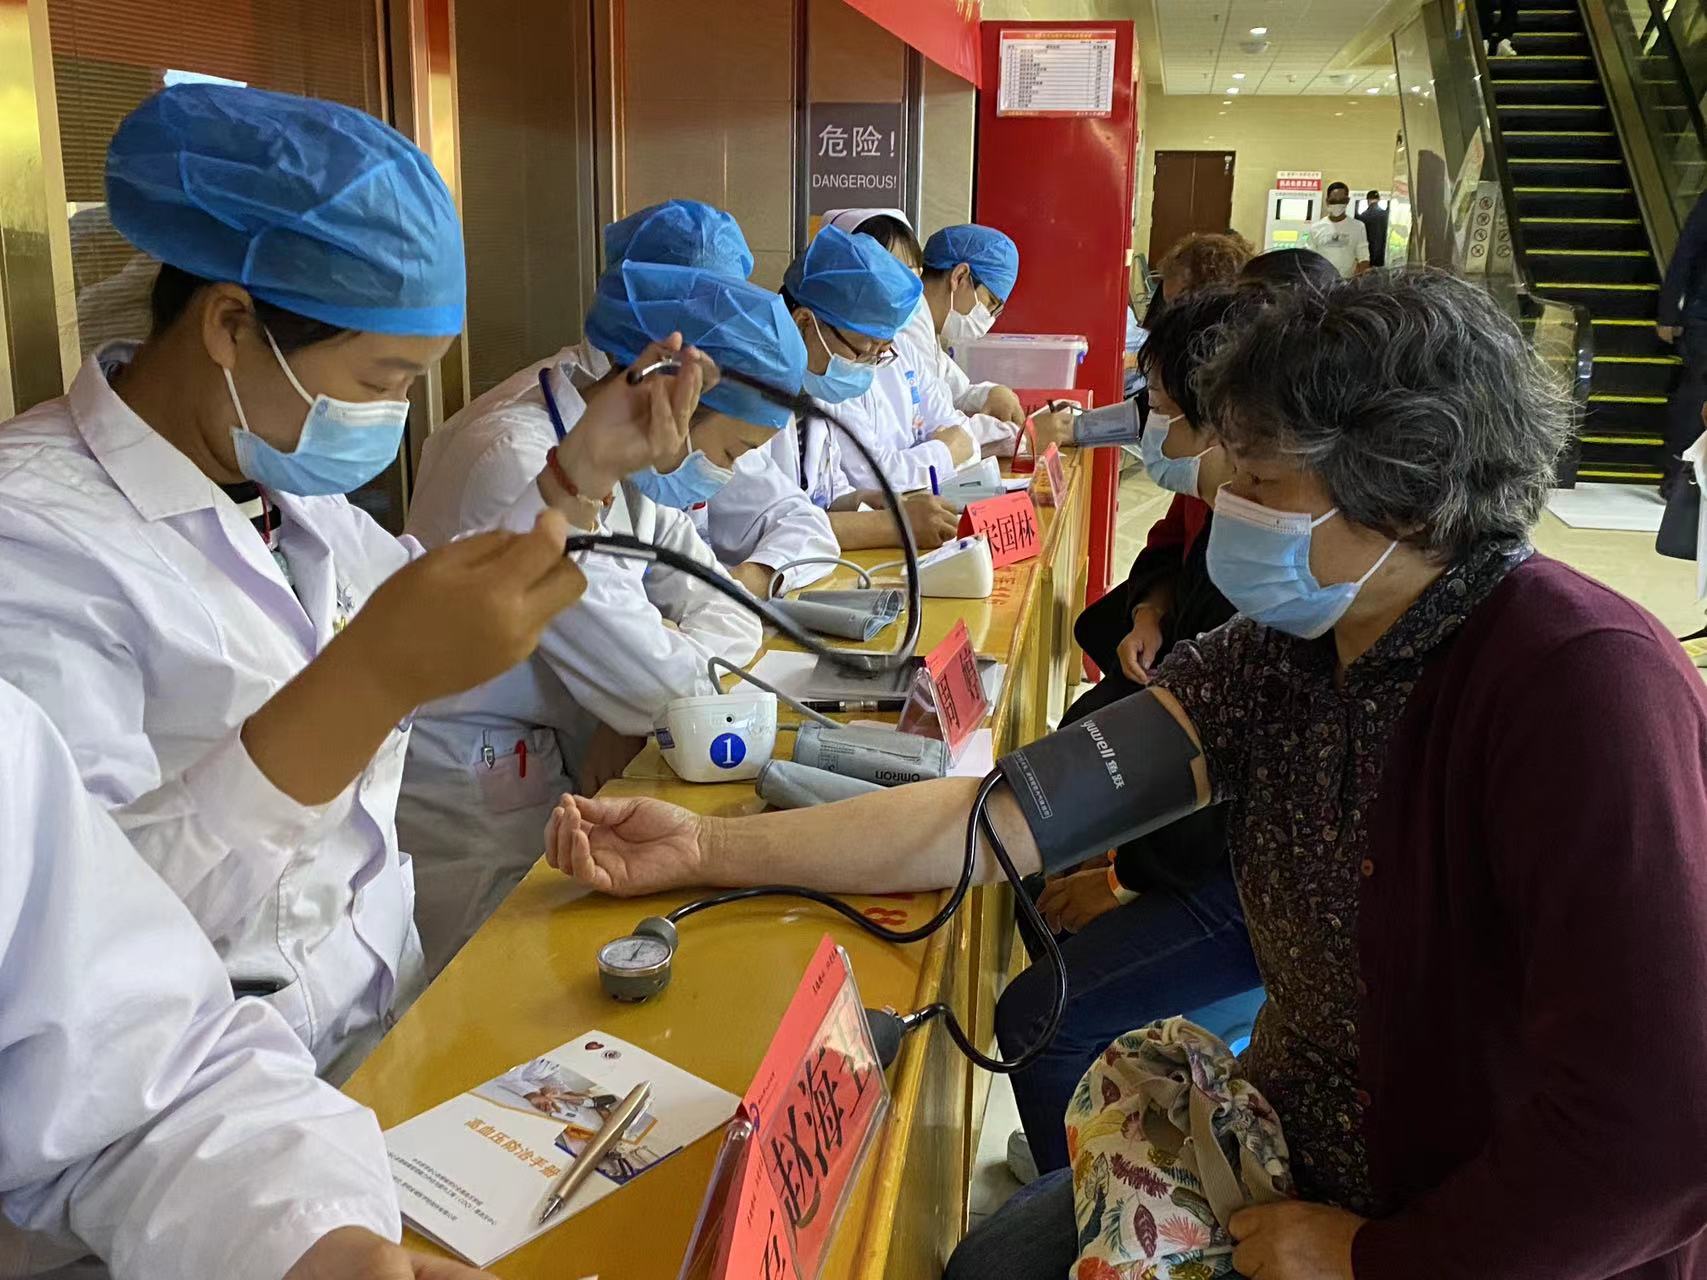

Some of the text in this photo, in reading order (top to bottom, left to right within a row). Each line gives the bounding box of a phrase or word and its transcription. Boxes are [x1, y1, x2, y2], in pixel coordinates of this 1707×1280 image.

[818, 124, 896, 158] 危险!
[812, 174, 897, 189] DANGEROUS!
[979, 510, 1036, 559] 宋国林
[722, 737, 735, 764] 1
[1080, 720, 1125, 789] yuwell 鱼跃
[875, 770, 920, 783] OMRON
[464, 1117, 561, 1179] 高血压防治手册
